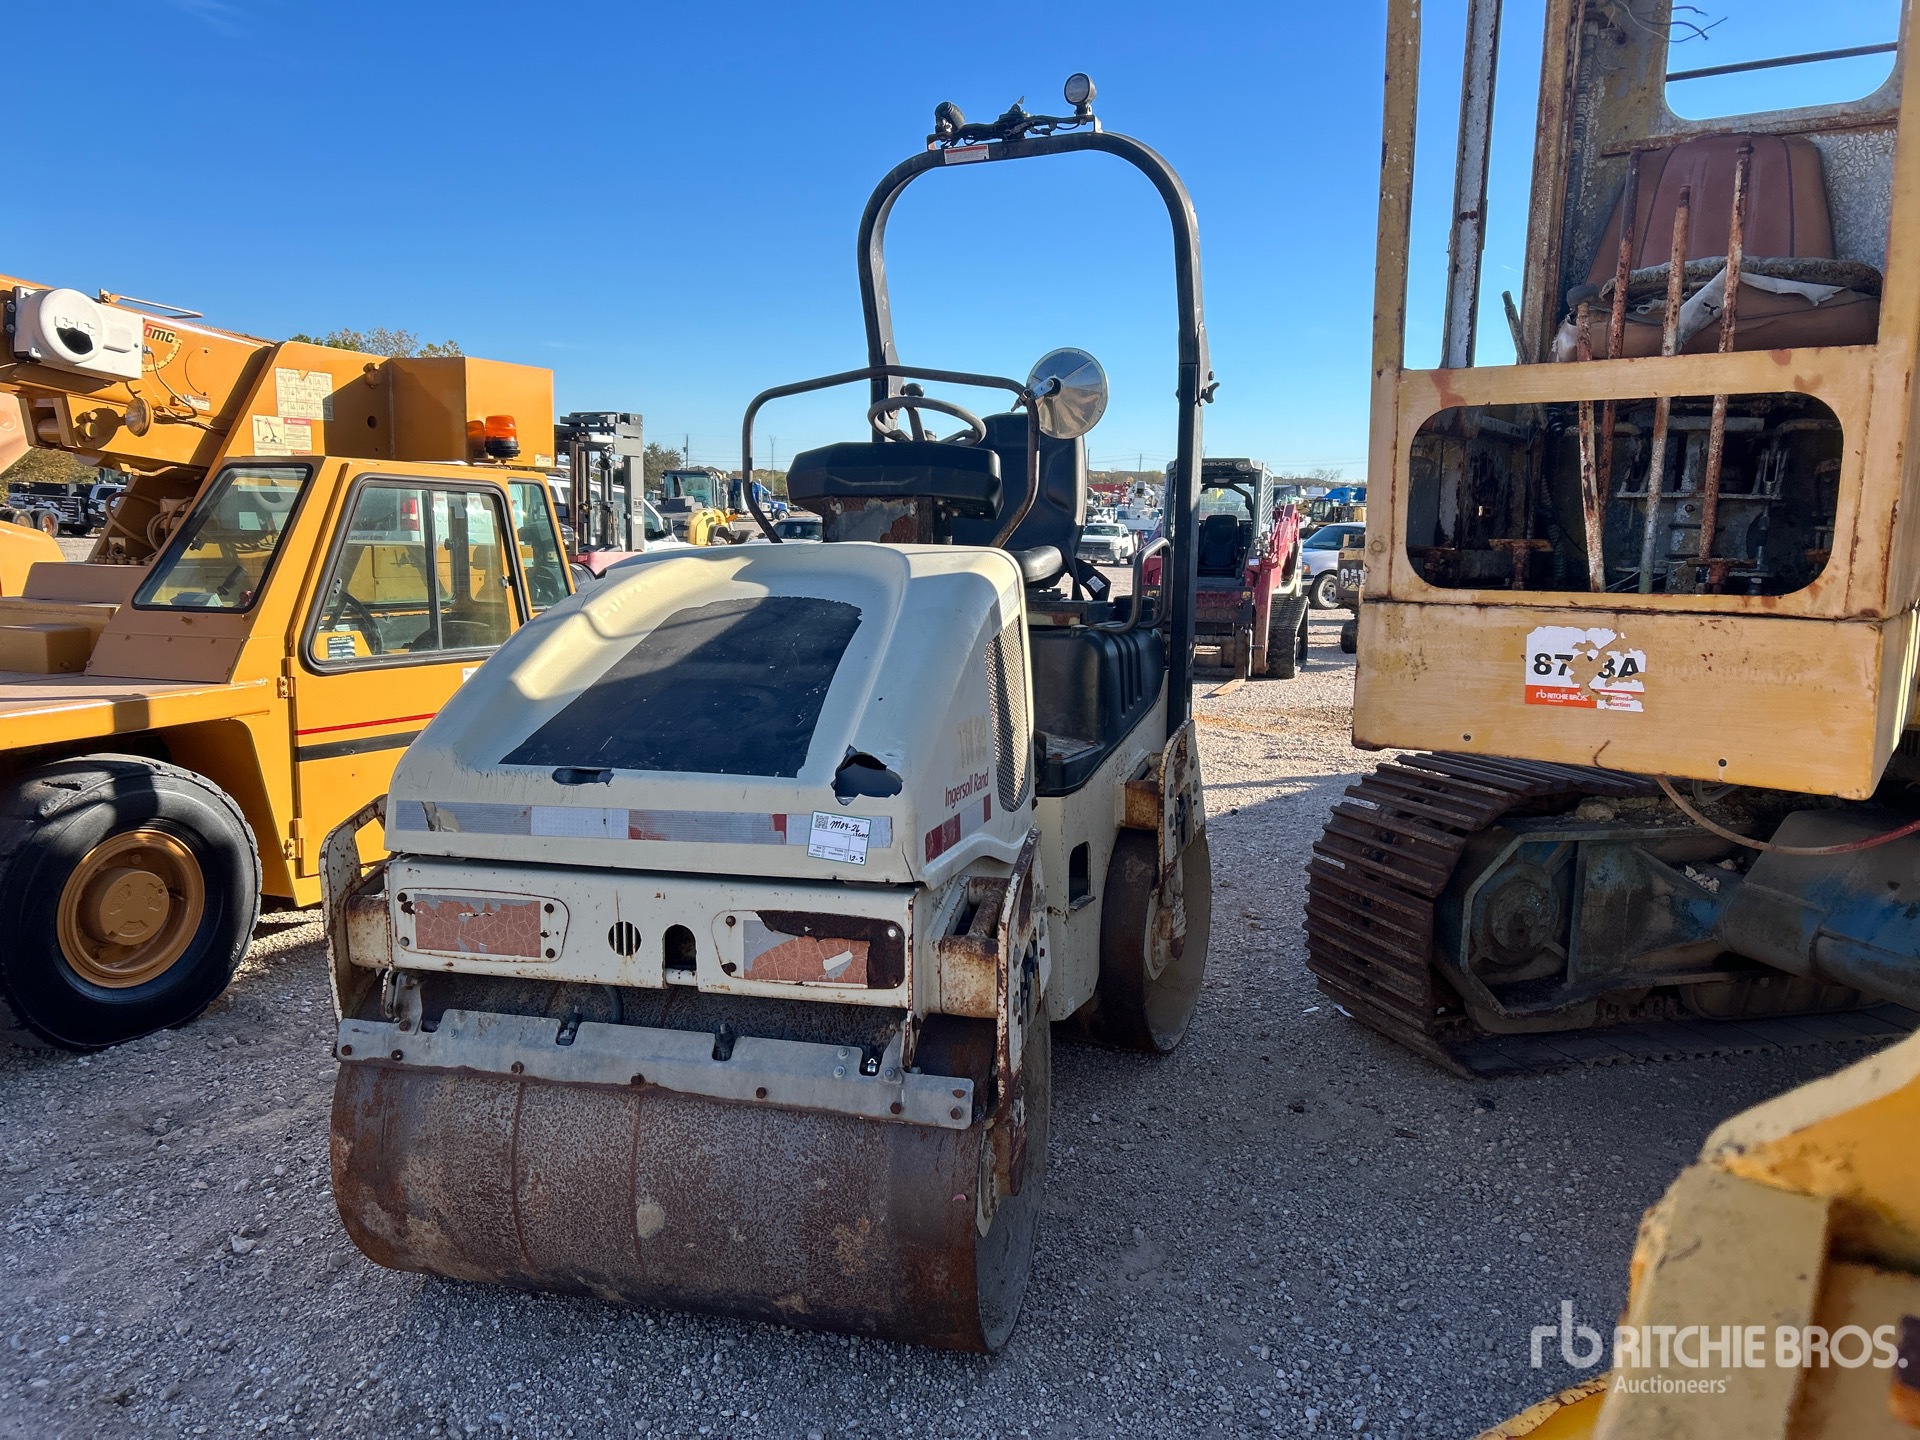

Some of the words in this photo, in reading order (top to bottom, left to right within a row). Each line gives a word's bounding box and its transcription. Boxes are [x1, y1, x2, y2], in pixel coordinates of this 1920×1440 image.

[1533, 652, 1639, 679] 873A
[945, 773, 973, 809] Ingersoll
[973, 767, 989, 793] Rand
